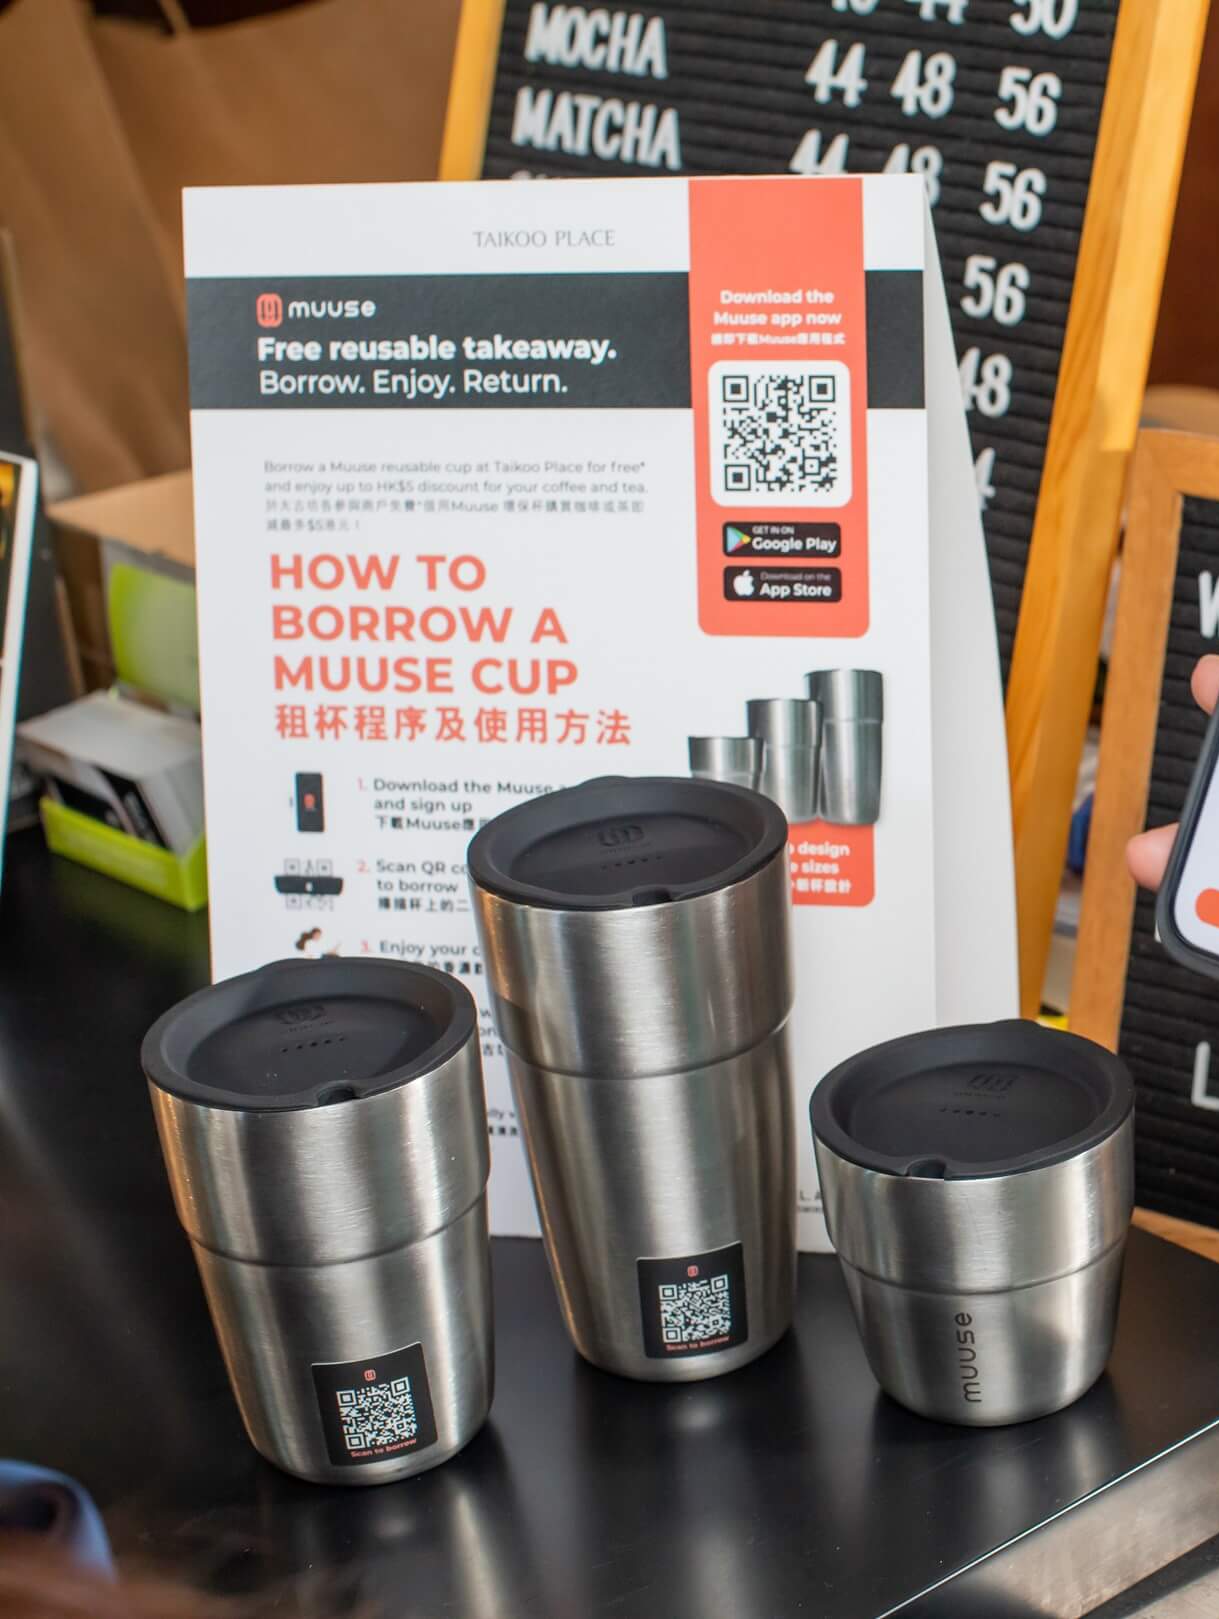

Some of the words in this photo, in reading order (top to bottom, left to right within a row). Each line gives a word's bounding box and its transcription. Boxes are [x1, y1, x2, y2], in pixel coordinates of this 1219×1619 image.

[524, 2, 668, 79] MOCHA
[804, 38, 868, 108] 44
[890, 49, 957, 117] 48
[994, 66, 1062, 136] 56
[511, 86, 682, 171] MATCHA
[979, 161, 1046, 230] 56
[472, 231, 548, 248] TAIKOO
[555, 229, 616, 247] PLACE
[720, 289, 802, 304] Download
[805, 289, 834, 304] the
[961, 253, 1030, 326] 56
[288, 300, 376, 318] muuse
[713, 312, 767, 325] Muuse
[771, 313, 803, 328] app
[805, 313, 842, 325] now
[257, 337, 322, 361] Free
[329, 334, 457, 361] reusable
[462, 334, 617, 365] takeaway.
[259, 370, 366, 394] Borrow.
[373, 368, 455, 399] Enjoy.
[464, 369, 568, 393] Return.
[959, 347, 1013, 417] 48
[264, 460, 314, 473] Borrow
[318, 464, 326, 473] a
[330, 461, 377, 473] Muuse
[381, 460, 441, 474] reusable
[445, 464, 472, 476] cup
[476, 462, 489, 474] at
[494, 461, 540, 474] Taikoo
[544, 462, 583, 474] Place
[587, 461, 607, 474] for
[265, 480, 291, 492] and
[295, 480, 332, 494] enjoy
[336, 483, 354, 494] up
[359, 480, 373, 492] to
[378, 480, 414, 492] HK$5
[417, 480, 479, 493] discount
[484, 480, 501, 493] for
[505, 483, 537, 495] your
[542, 480, 587, 493] coffee
[590, 480, 618, 494] and
[622, 481, 648, 494] tea.
[752, 537, 803, 553] Google
[805, 537, 837, 553] Play
[270, 554, 400, 590] HOW
[416, 554, 487, 591] TO
[760, 583, 790, 598] App
[793, 583, 832, 597] Store
[271, 604, 513, 643] BORROW
[530, 607, 568, 643] A
[273, 656, 454, 693] MUUSE
[471, 658, 578, 695] CUP
[275, 704, 631, 745] 租杯程序及使用方法
[373, 778, 459, 793] Download
[464, 780, 491, 794] the
[497, 782, 553, 795] Muuse
[374, 798, 405, 811] and
[411, 798, 446, 814] sign
[451, 801, 473, 814] up
[798, 841, 850, 858] design
[377, 860, 416, 873] Scan
[421, 861, 446, 875] QR
[802, 860, 840, 875] sizes
[377, 880, 394, 892] to
[398, 879, 458, 893] borrow
[380, 940, 425, 957] Enjoy
[430, 944, 468, 957] your
[954, 1311, 982, 1402] muuse
[351, 1449, 373, 1458] Scan
[374, 1447, 384, 1455] to
[385, 1438, 417, 1452] borrow
